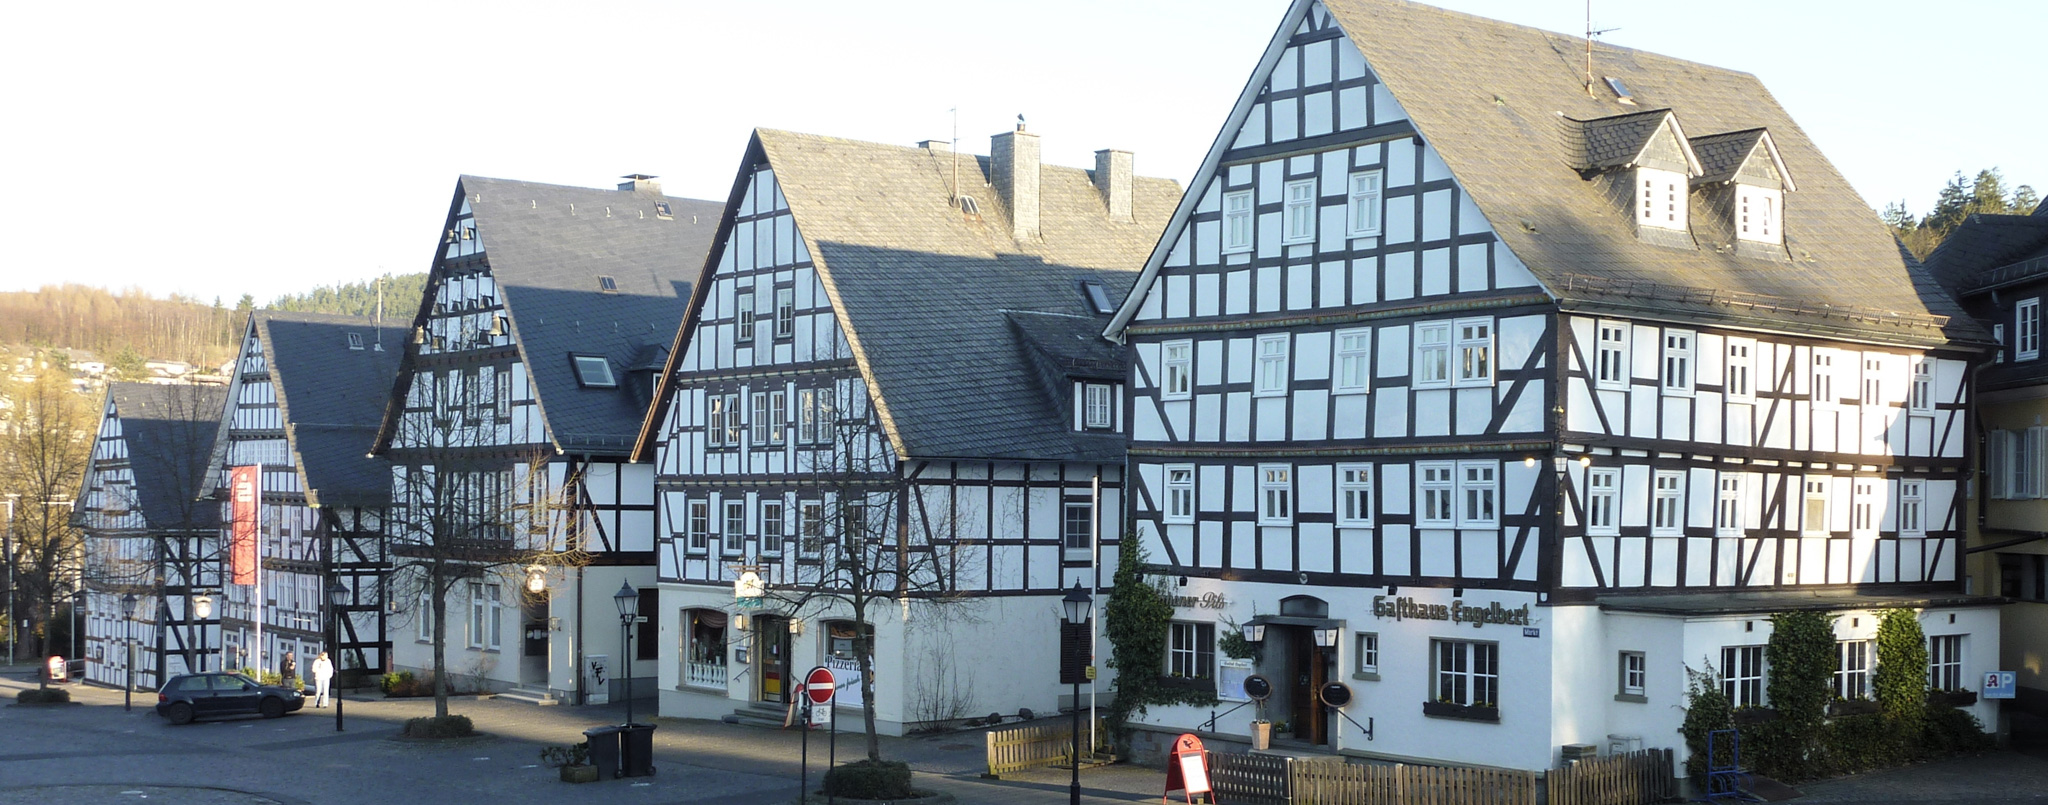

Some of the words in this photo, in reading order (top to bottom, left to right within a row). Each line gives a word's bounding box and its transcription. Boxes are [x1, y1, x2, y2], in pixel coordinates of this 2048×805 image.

[1200, 591, 1225, 609] Pils
[1451, 600, 1529, 628] Engelbert
[825, 654, 862, 671] Pizzeria
[2001, 673, 2013, 688] P
